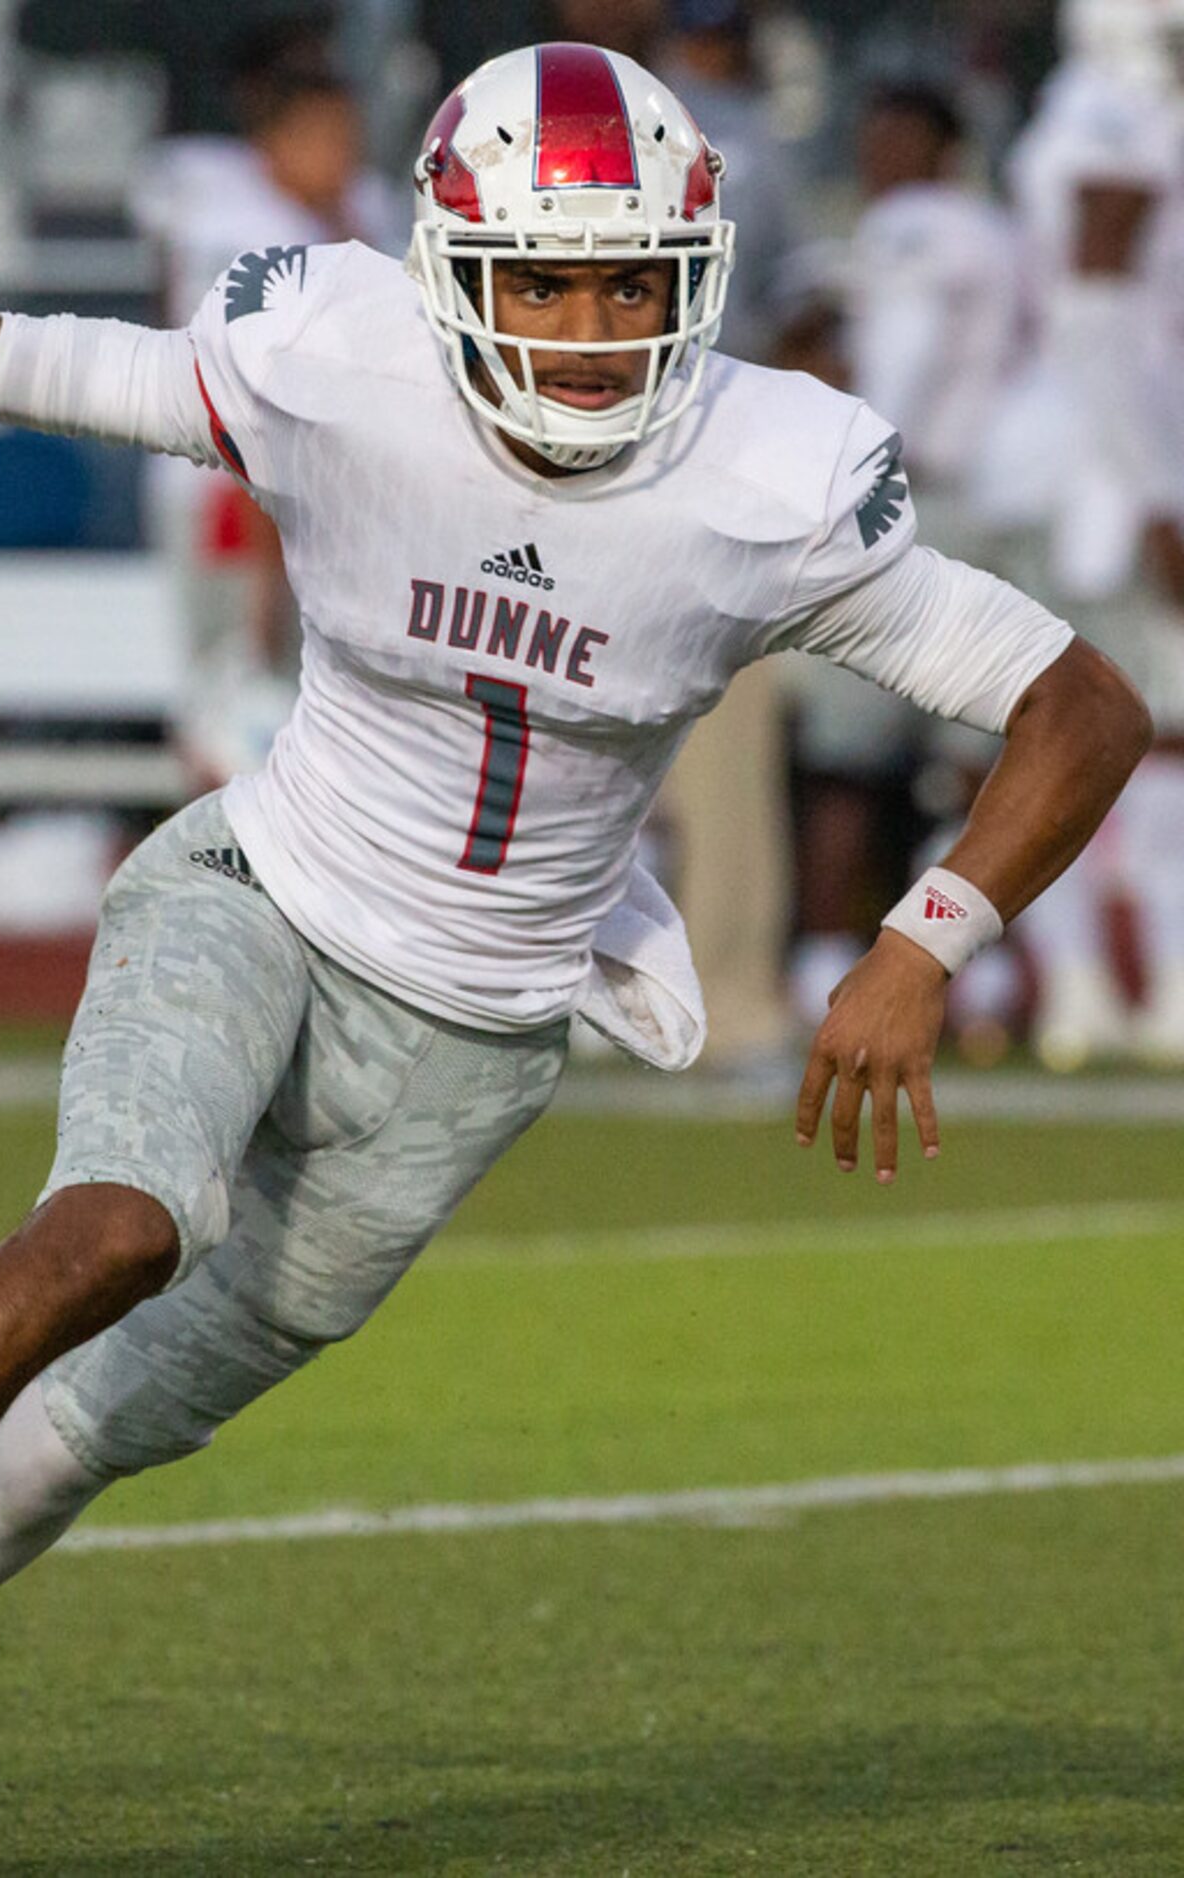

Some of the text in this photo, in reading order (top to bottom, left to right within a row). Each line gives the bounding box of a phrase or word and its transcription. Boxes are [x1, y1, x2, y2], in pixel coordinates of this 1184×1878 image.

[481, 559, 555, 591] adidas
[407, 578, 610, 688] DUNNE
[456, 672, 530, 876] 1
